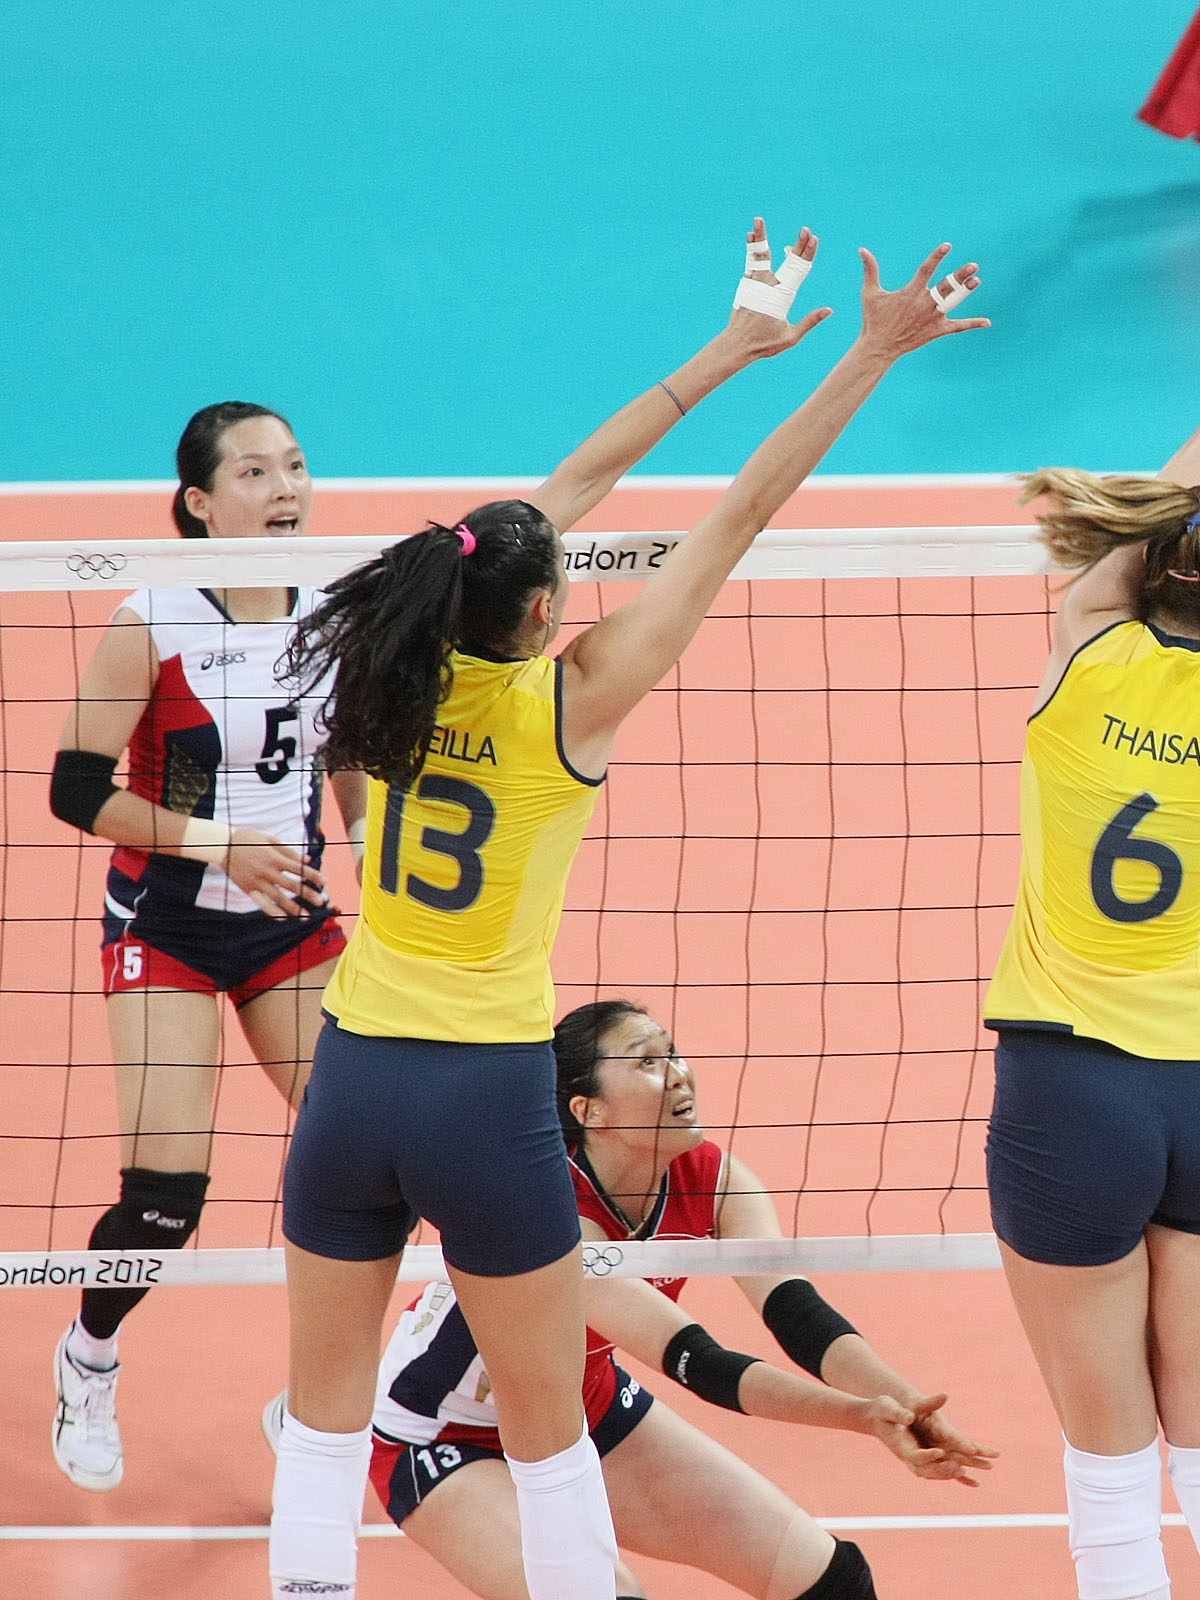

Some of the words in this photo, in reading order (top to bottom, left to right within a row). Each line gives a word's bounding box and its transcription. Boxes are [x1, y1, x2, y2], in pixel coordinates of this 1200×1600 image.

[564, 542, 637, 571] ndon
[215, 651, 246, 667] asics
[255, 706, 298, 785] 5
[428, 724, 498, 766] EILLA
[379, 773, 497, 912] 13
[1090, 791, 1183, 923] 6
[122, 945, 143, 981] 5
[0, 1259, 85, 1285] ondon
[96, 1258, 163, 1284] 2012
[416, 1443, 462, 1479] 13
